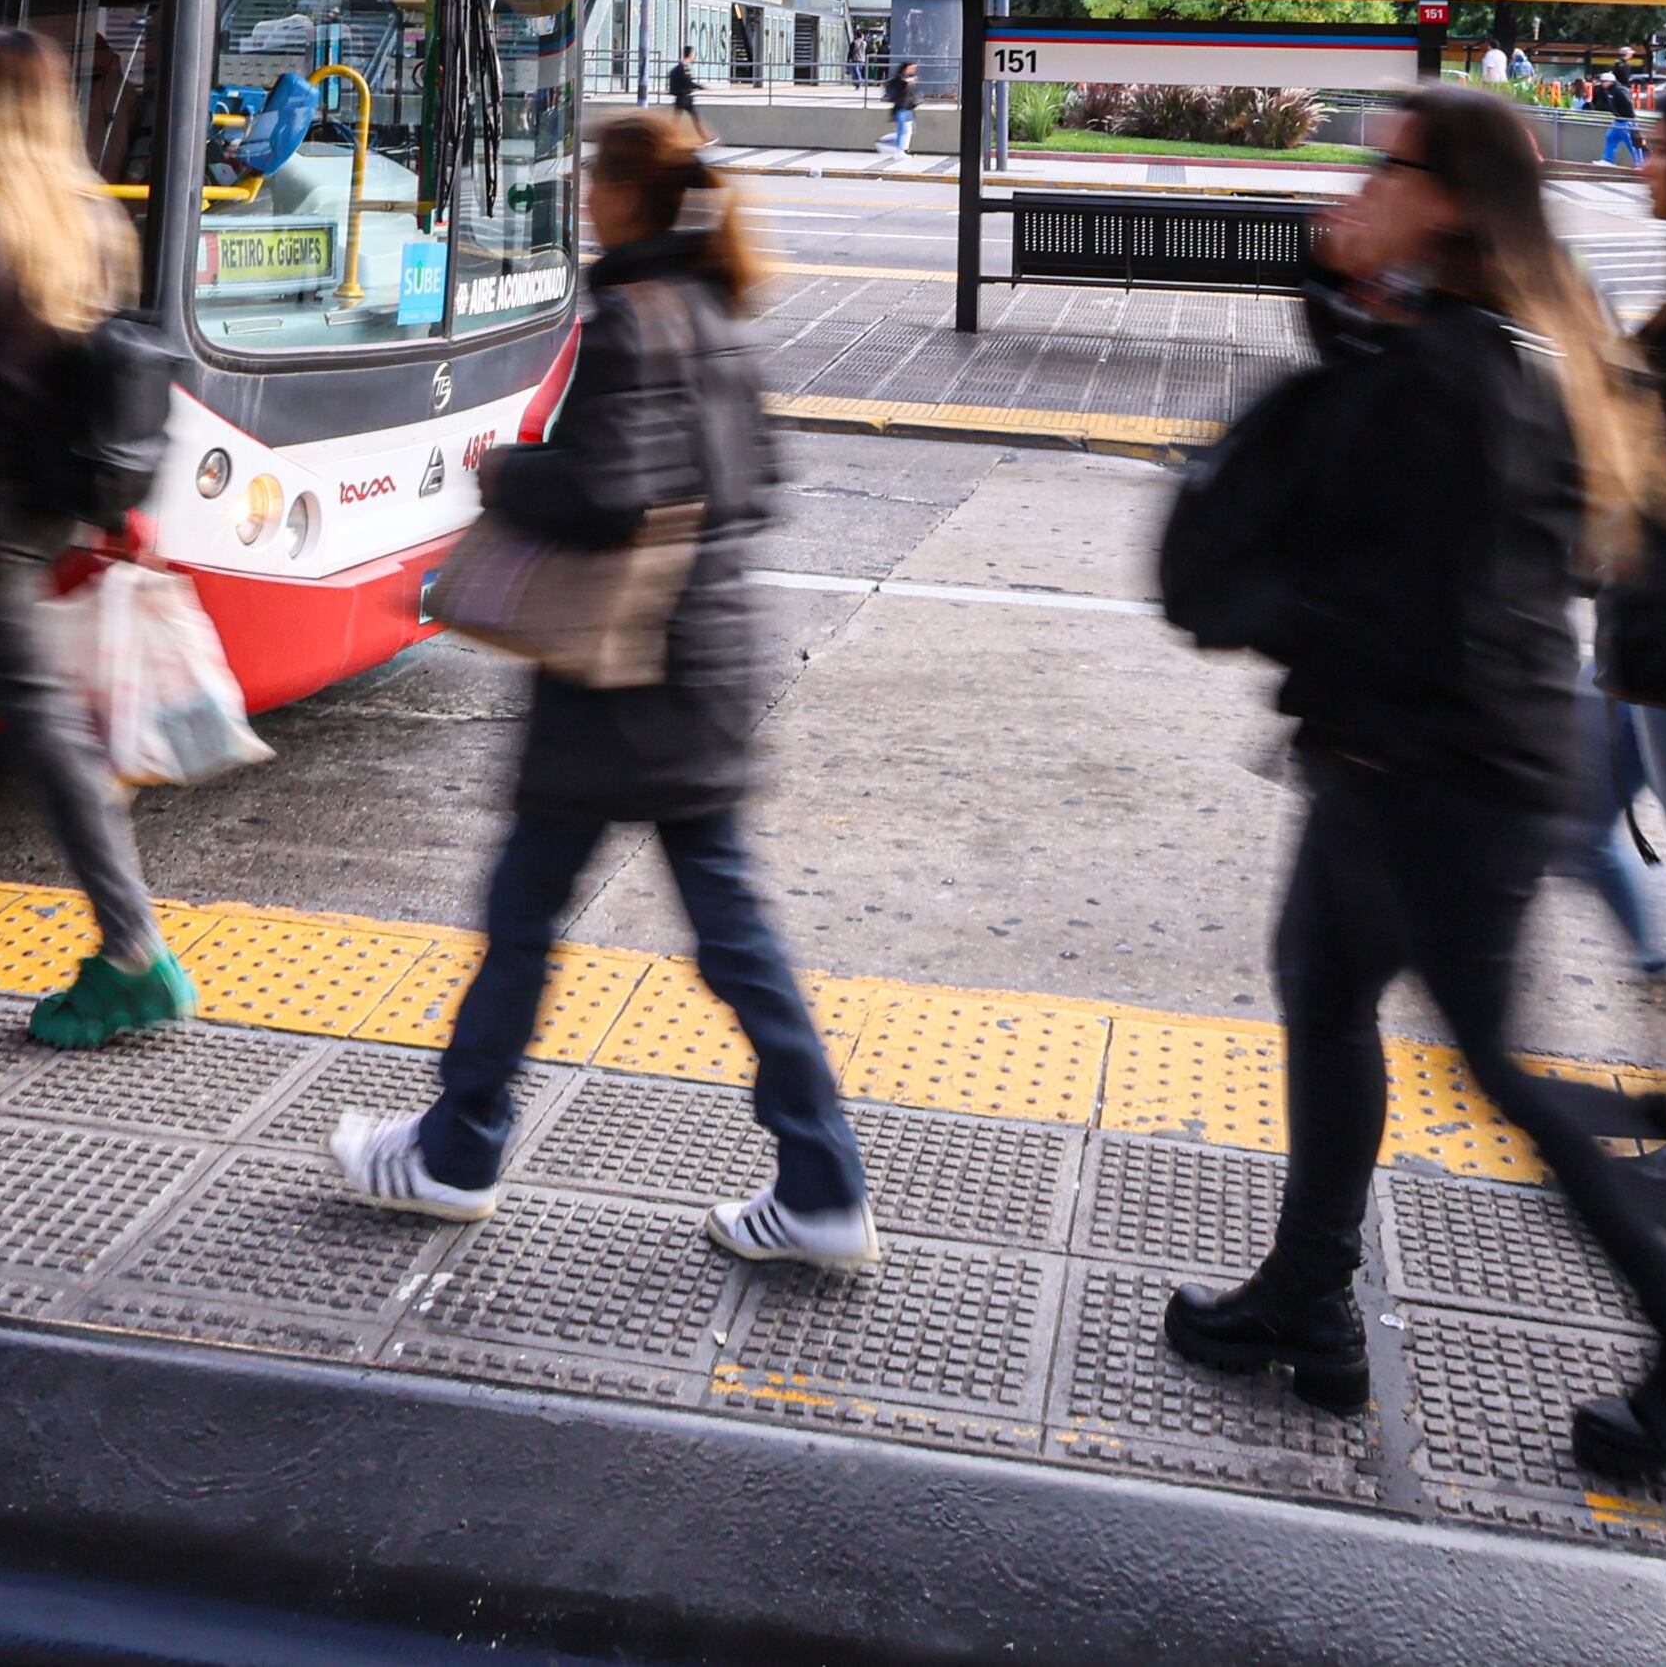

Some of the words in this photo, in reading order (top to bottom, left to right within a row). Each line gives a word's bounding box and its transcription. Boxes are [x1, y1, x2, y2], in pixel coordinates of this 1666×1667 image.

[1424, 8, 1443, 19] 151
[994, 49, 1037, 73] 151
[221, 238, 264, 268] RETIRO
[404, 266, 442, 296] SUBE
[469, 276, 497, 315] AIRE
[496, 266, 567, 313] ACONDICIONADO
